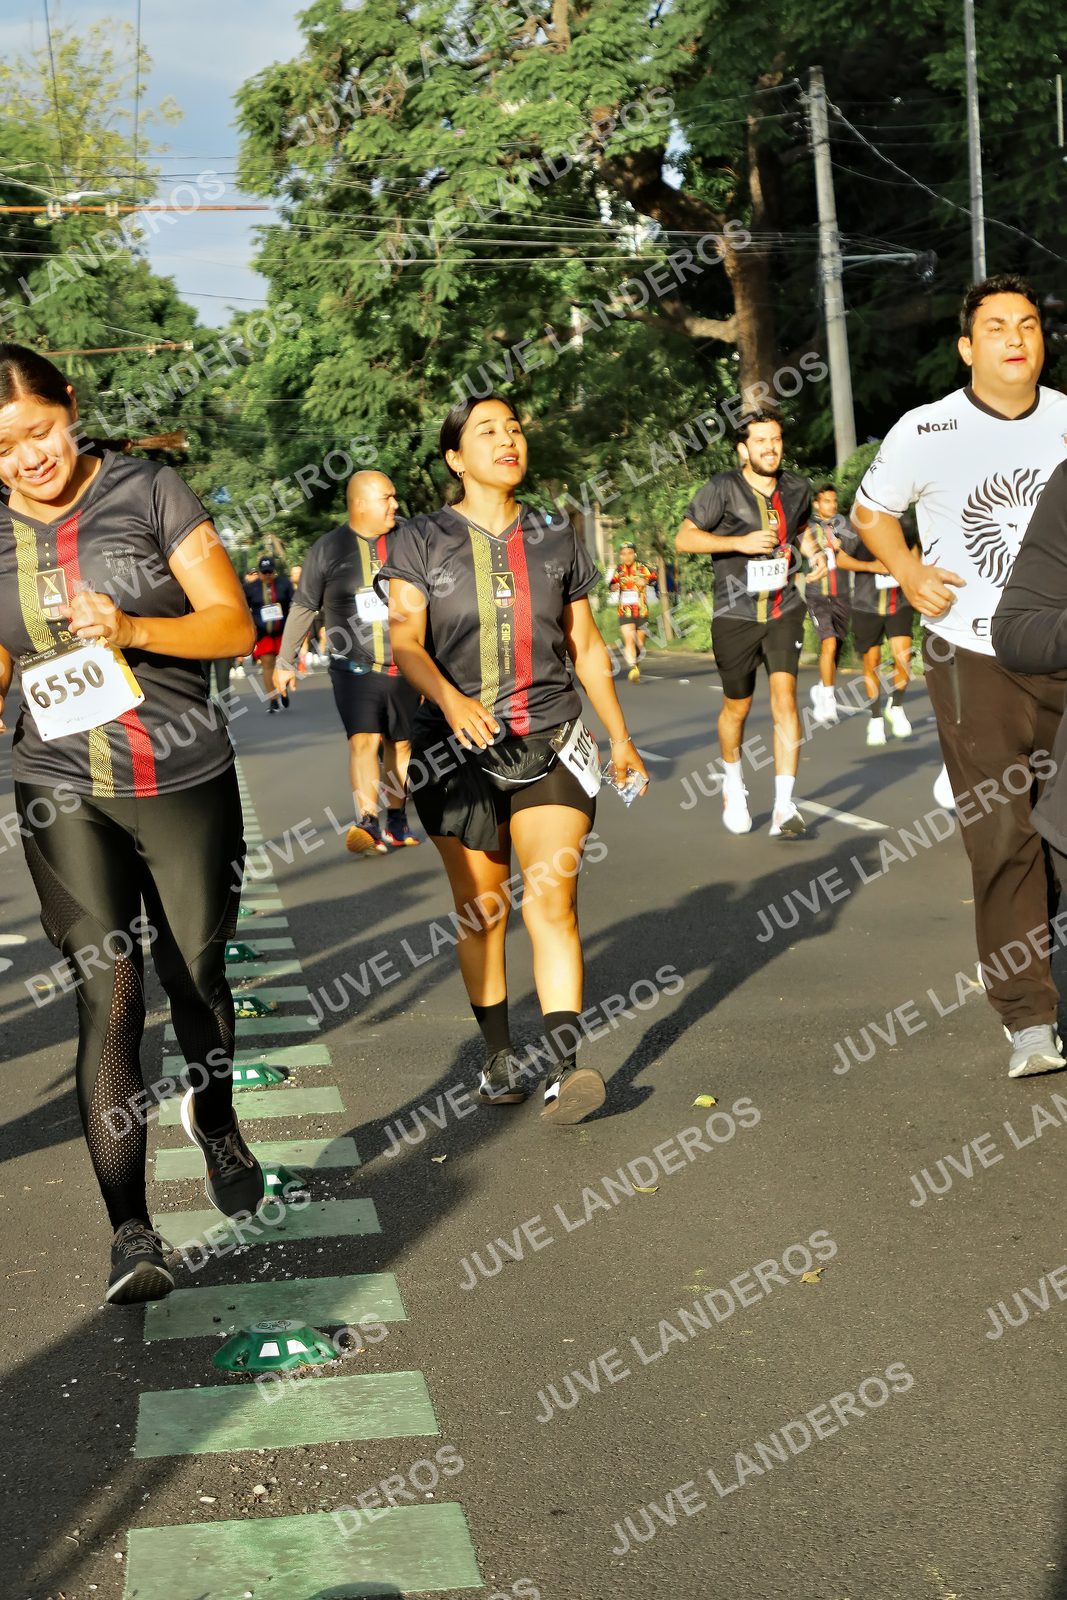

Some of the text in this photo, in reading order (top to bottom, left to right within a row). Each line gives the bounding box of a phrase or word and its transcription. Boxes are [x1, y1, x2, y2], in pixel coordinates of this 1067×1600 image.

[917, 418, 958, 436] Nazil
[752, 562, 787, 577] 11283
[30, 660, 105, 709] 6550
